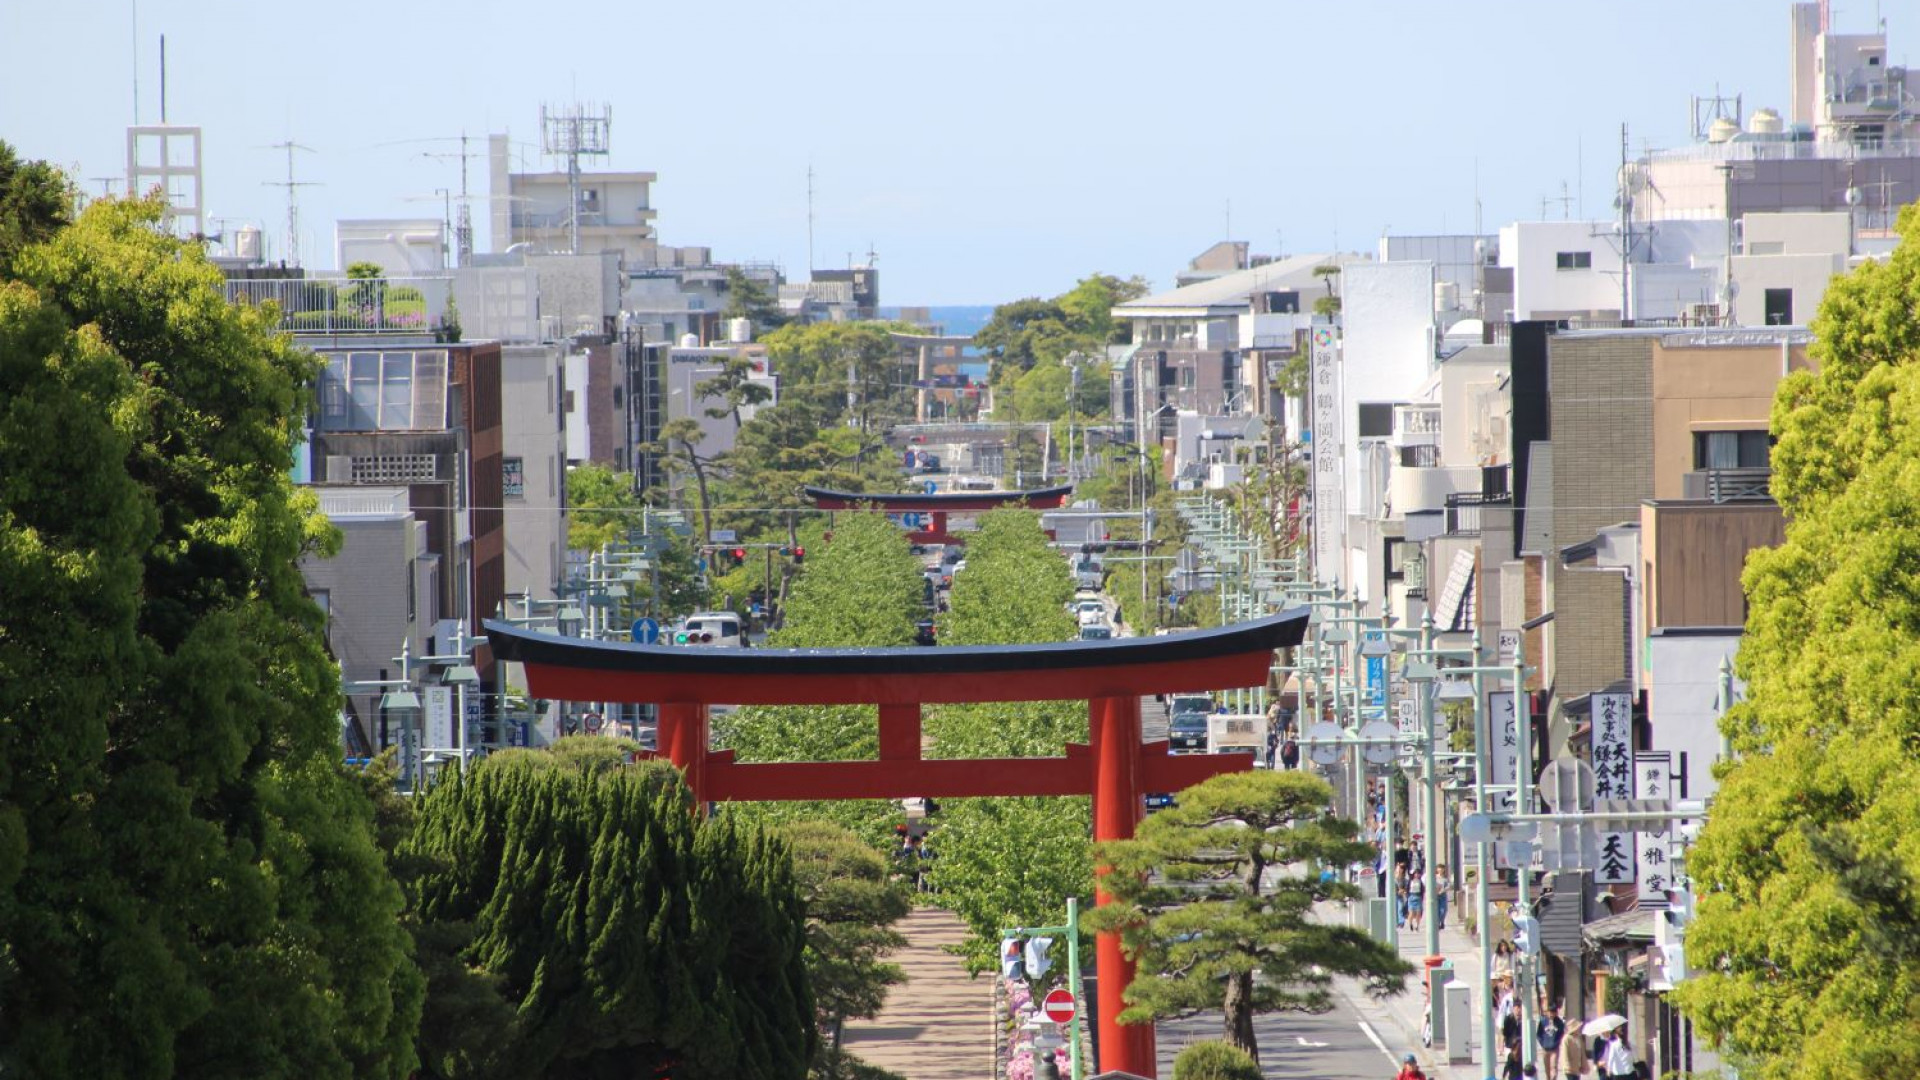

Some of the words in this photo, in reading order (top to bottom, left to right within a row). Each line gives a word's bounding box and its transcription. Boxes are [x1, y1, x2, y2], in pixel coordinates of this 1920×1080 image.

[1602, 696, 1617, 742] 御食事処
[1595, 744, 1612, 799] 鎌倉丼
[1612, 741, 1629, 800] 天丼各
[1601, 834, 1628, 880] 天金
